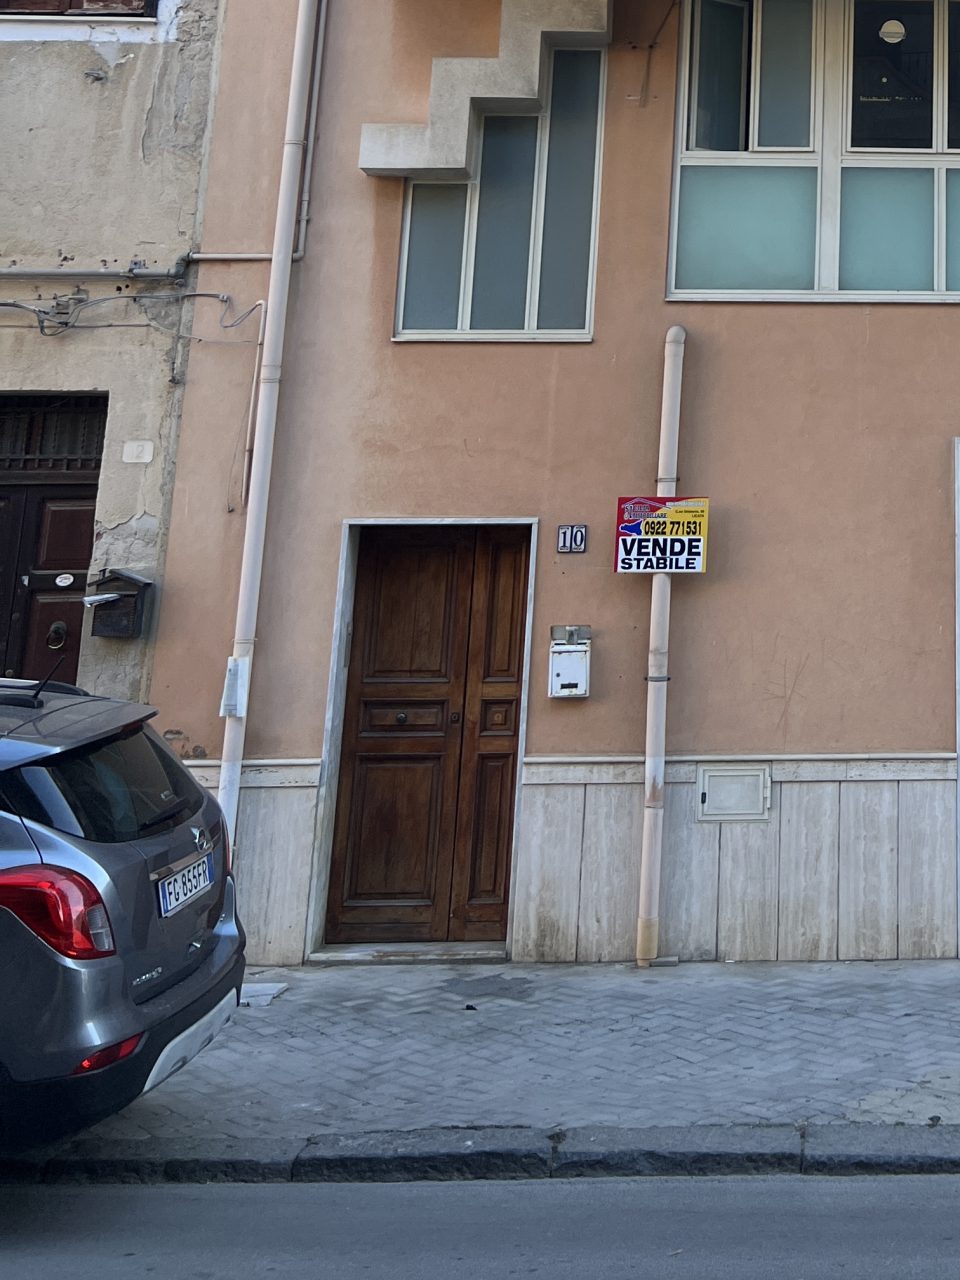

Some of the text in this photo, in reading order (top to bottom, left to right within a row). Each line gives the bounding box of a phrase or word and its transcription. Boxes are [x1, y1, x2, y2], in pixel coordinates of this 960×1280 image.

[644, 521, 702, 536] 0922 771531
[561, 529, 584, 548] 10
[621, 538, 702, 556] VENDE
[620, 557, 697, 570] STABILE
